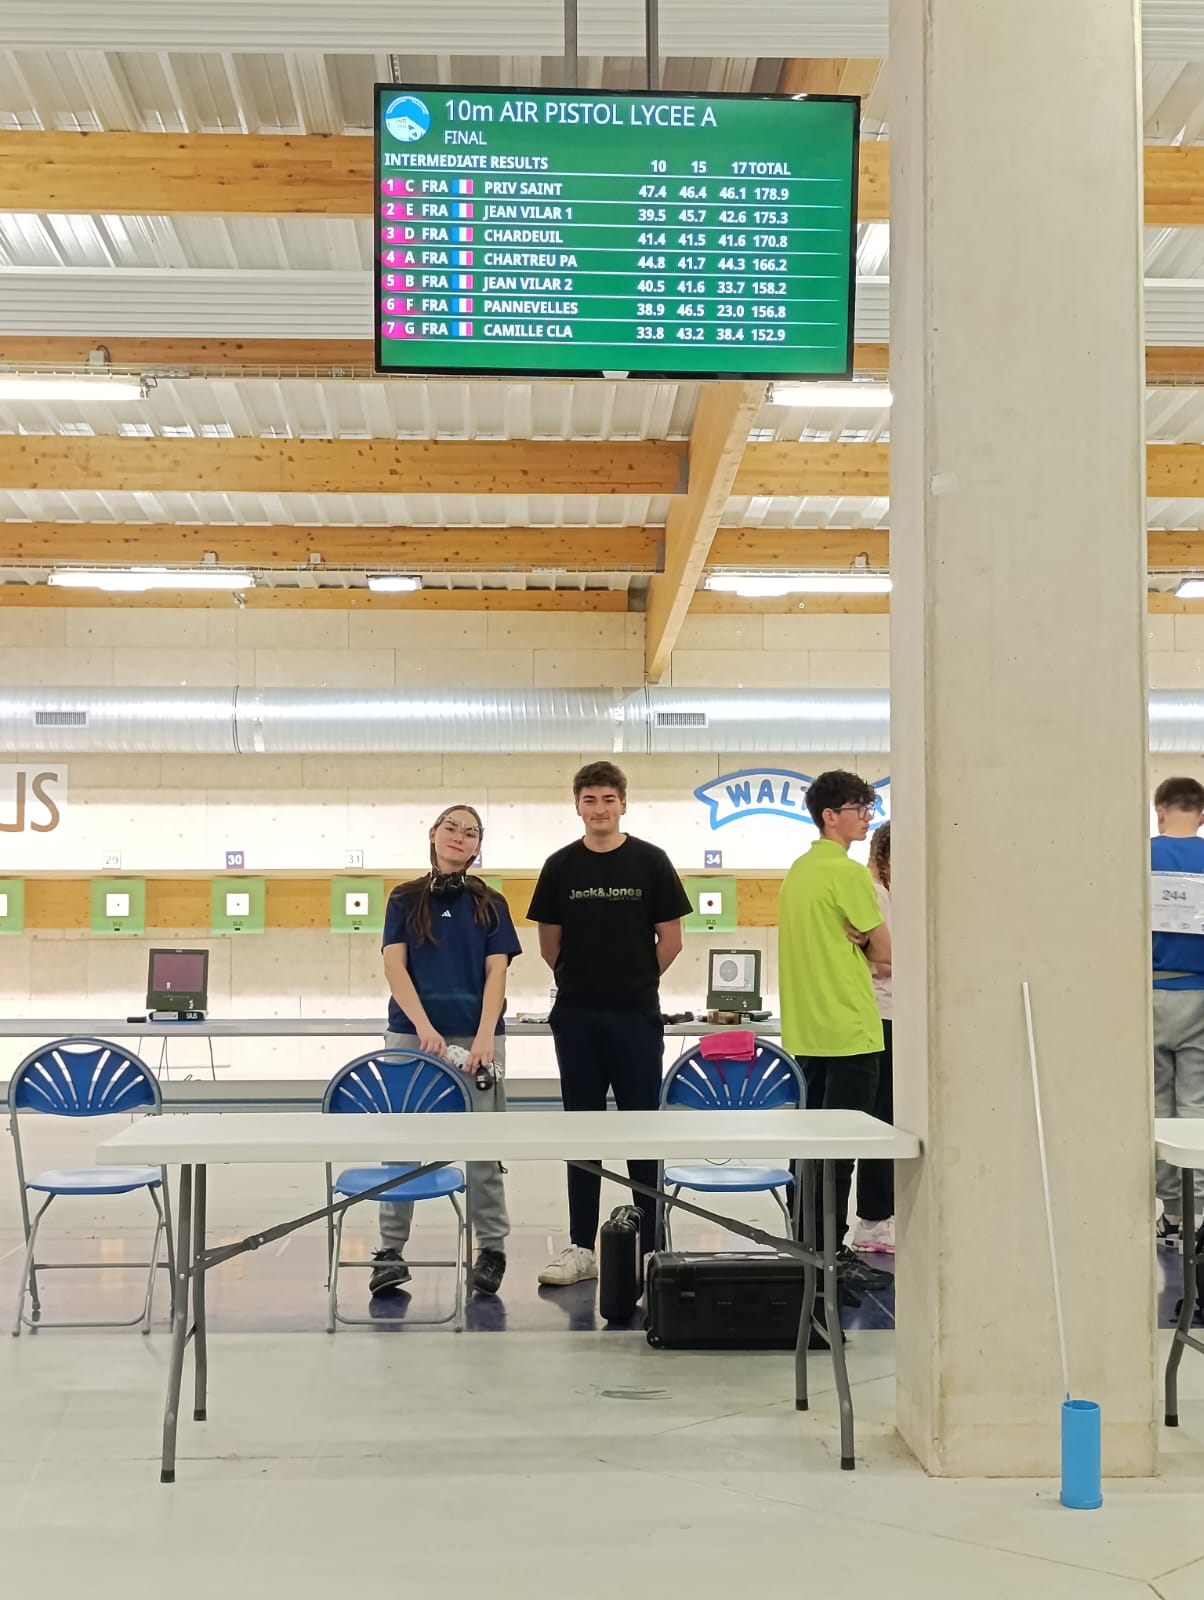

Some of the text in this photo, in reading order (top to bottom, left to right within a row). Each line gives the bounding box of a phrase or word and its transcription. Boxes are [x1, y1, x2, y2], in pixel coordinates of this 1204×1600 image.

[445, 99, 493, 122] 10m
[499, 101, 538, 123] AIR
[546, 102, 624, 125] PISTOL
[631, 104, 695, 126] LYCEE
[701, 106, 717, 127] A
[444, 130, 487, 145] FINAL
[384, 153, 791, 175] INTERMEDIATE RESULTS 10 15 17 TOTAL
[386, 178, 789, 201] 1 C FRA PRIV SAINT 47.4 46.4 46.1 178.9
[386, 202, 788, 224] 2 E FRA JEAN VILAR 1 39.5 45.7 42.6 175.3
[386, 226, 788, 248] 3 D FRA CHARDEUIL 41.4 41.5 41.6 170.8
[386, 250, 787, 271] 4 A FRA CHARTREU PA 44.8 41.7 44.3 166.2
[386, 273, 787, 295] 5 B FRA JEAN VILAR 2 40.5 41.6 33.7 158.2
[386, 297, 786, 318] 6 F FRA PANNEVELLES 38.9 46.5 23.0 156.8
[386, 321, 786, 341] 7 G FRA CAMILLE CLA 33.8 43.2 38.4 152.9
[105, 855, 119, 865] 29
[227, 854, 243, 866] 30
[348, 854, 360, 864] 31
[706, 853, 721, 865] 34
[1161, 889, 1187, 901] 244
